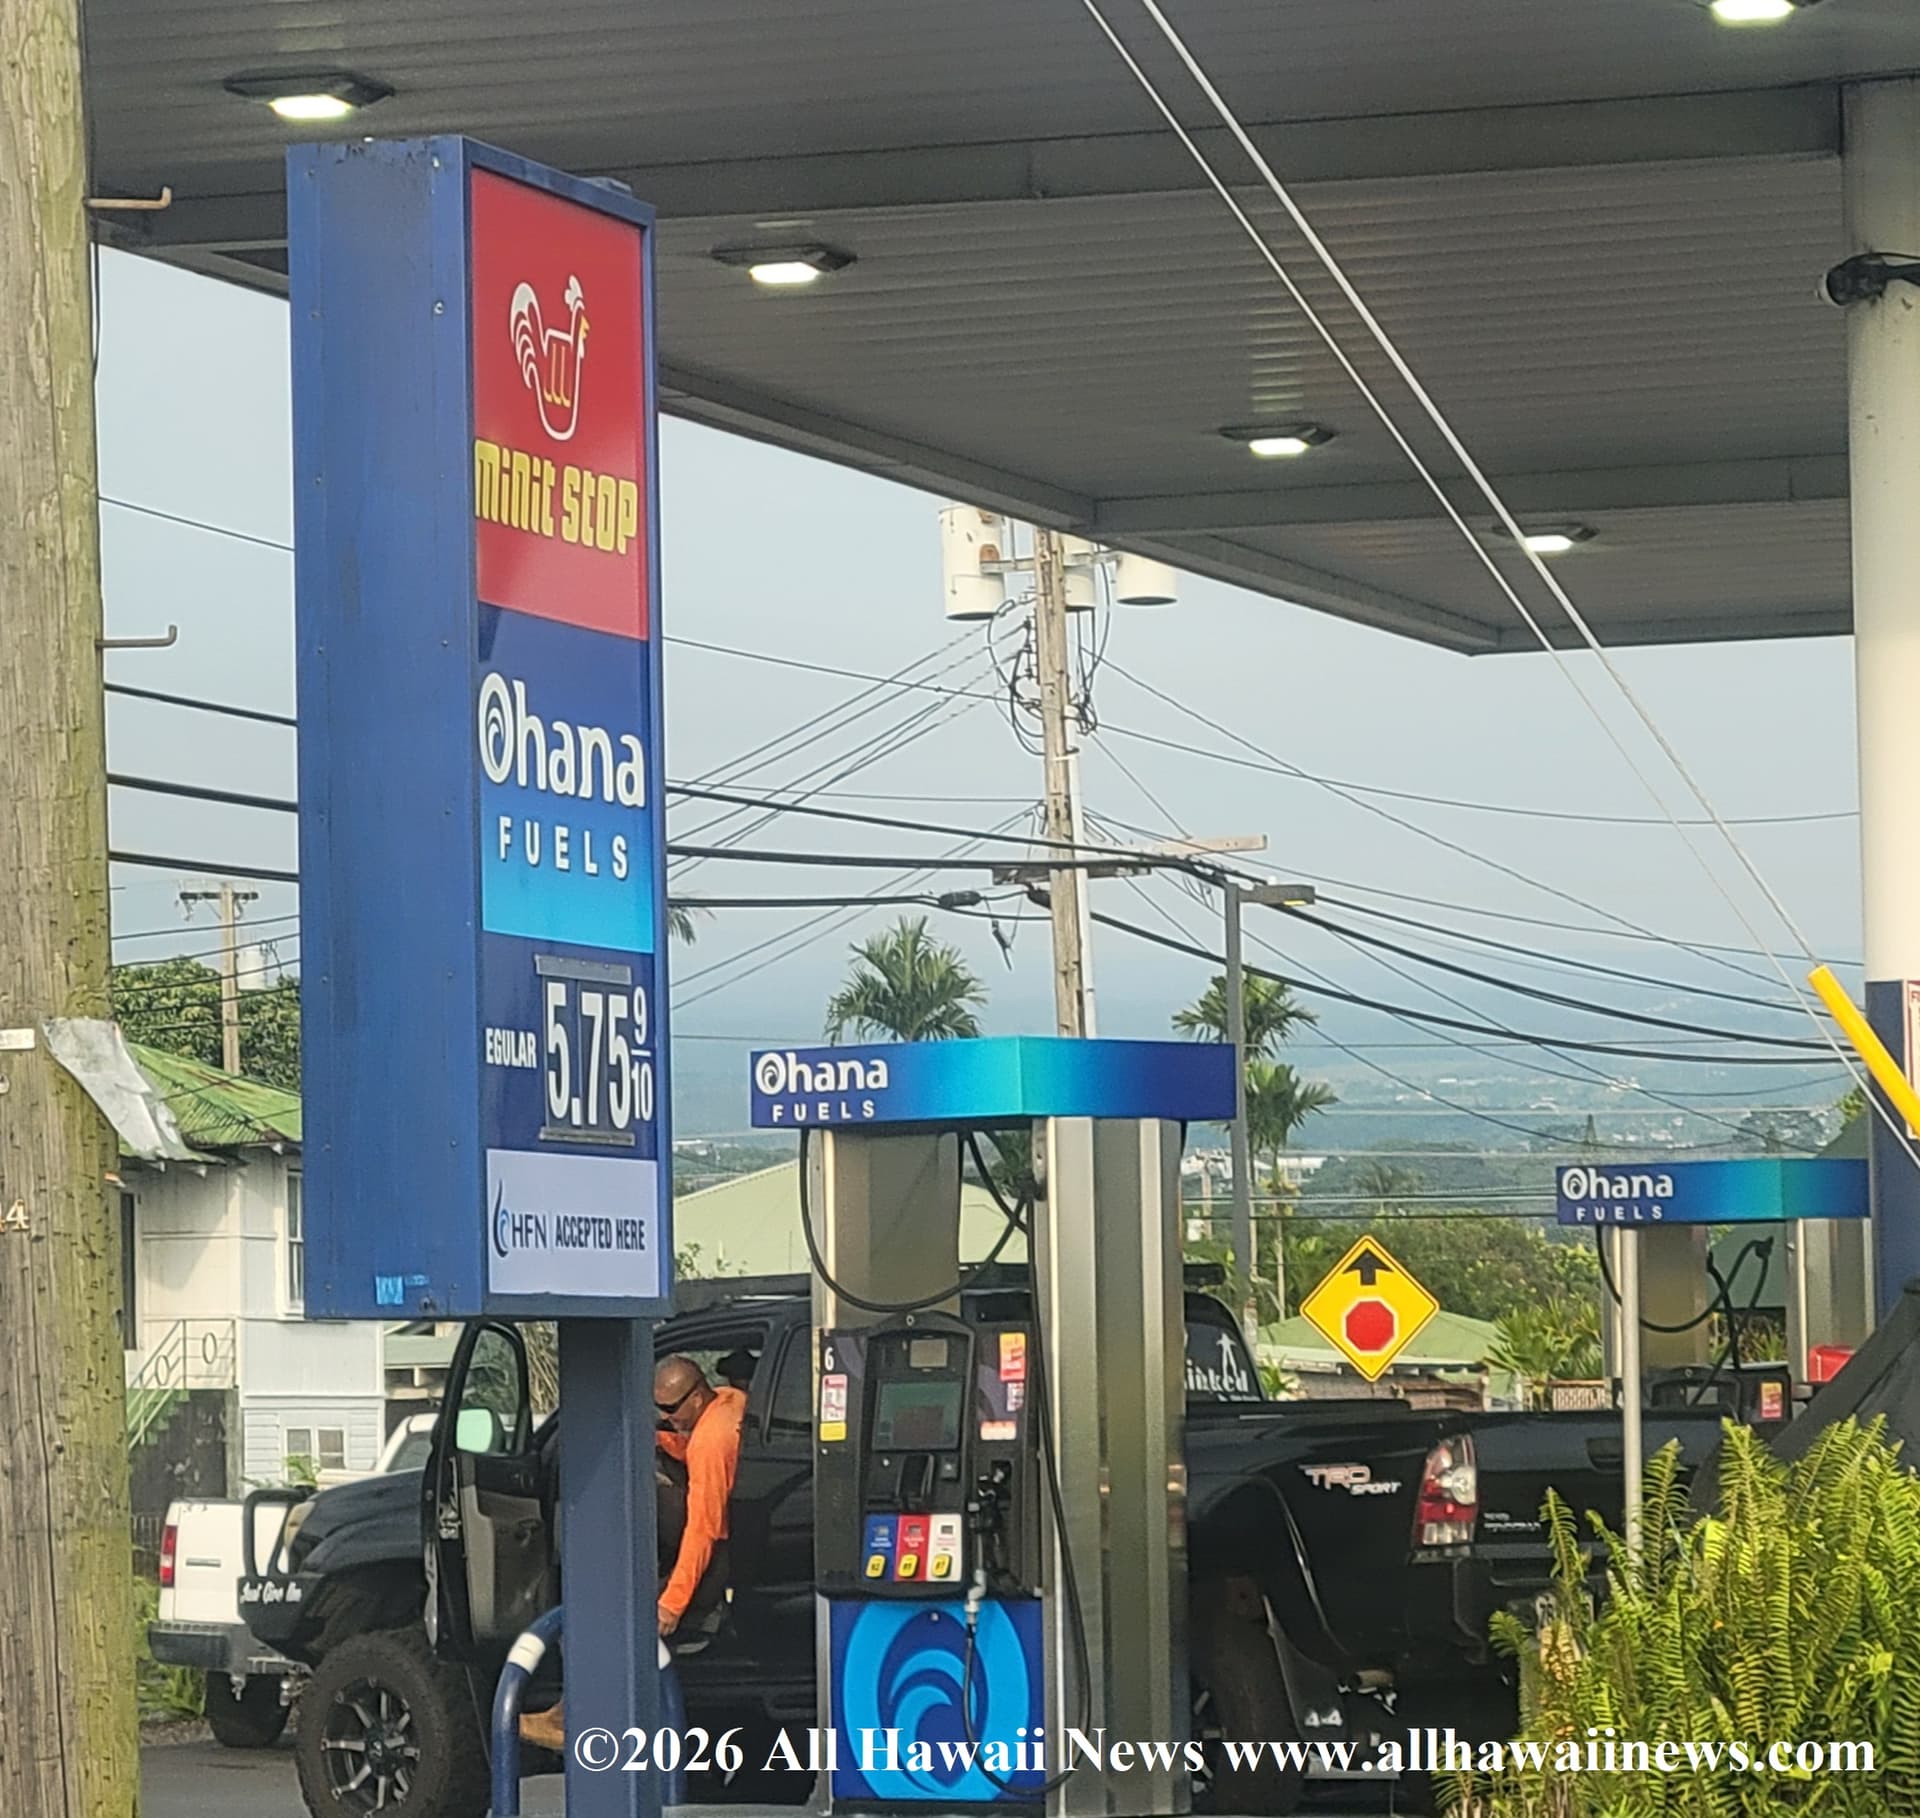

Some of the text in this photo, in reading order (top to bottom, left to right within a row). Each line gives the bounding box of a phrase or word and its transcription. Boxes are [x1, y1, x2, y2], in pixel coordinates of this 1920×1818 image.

[478, 672, 646, 808] Ohana
[499, 815, 629, 880] FUELS
[547, 982, 632, 1130] 5.75
[755, 1052, 889, 1096] Ohana
[772, 1099, 875, 1123] FUELS
[1562, 1167, 1674, 1200] Ohana
[0, 1199, 30, 1233] 4
[1575, 1205, 1663, 1222] FUELS
[511, 1214, 645, 1250] HFN ACCEPTED HERE
[824, 1346, 835, 1371] 6
[1303, 1463, 1402, 1495] TRD SPORT
